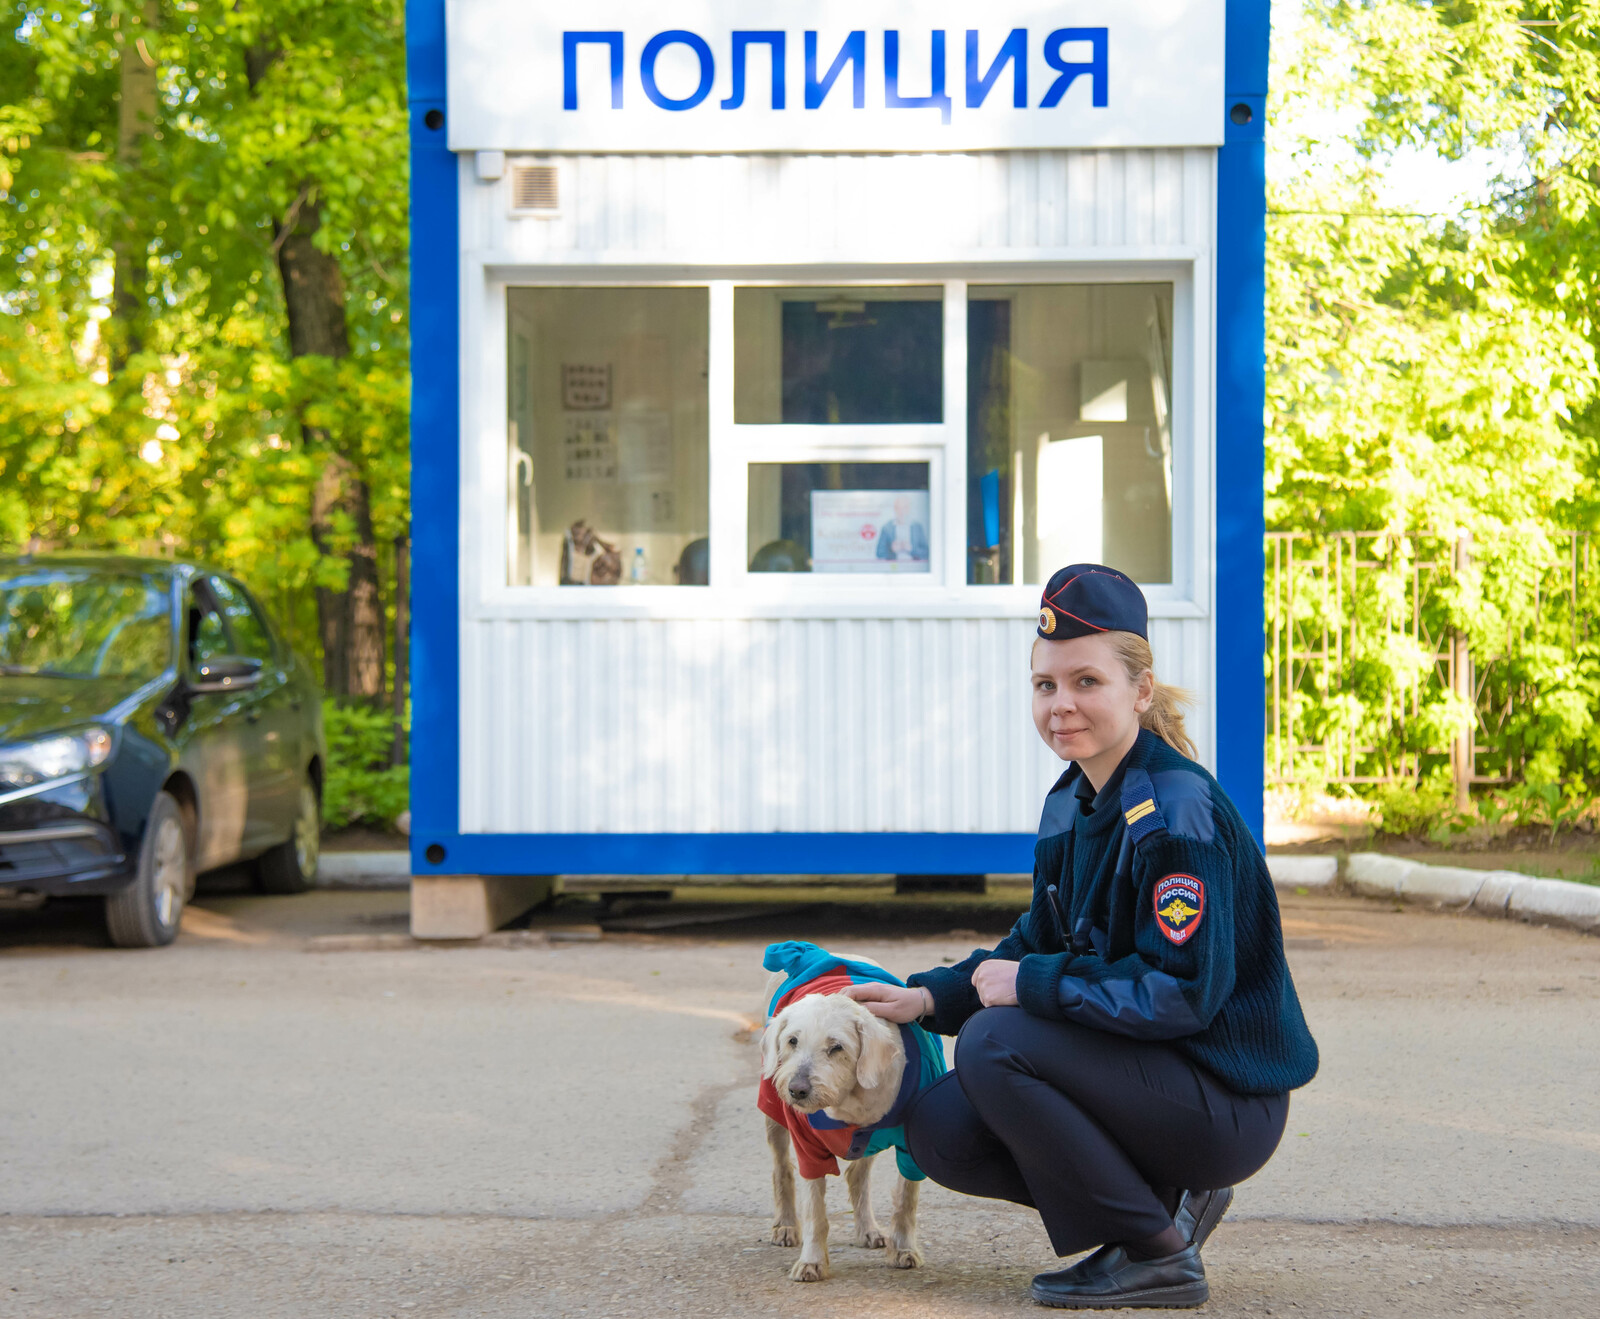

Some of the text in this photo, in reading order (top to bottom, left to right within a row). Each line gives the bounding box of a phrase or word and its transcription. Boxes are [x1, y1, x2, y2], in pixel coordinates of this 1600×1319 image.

[562, 27, 1110, 124] ПОЛИЦИЯ
[1158, 877, 1199, 893] ПОЛИЦИЯ
[1160, 888, 1197, 904] РОССИЯ
[1170, 929, 1186, 941] МВД
